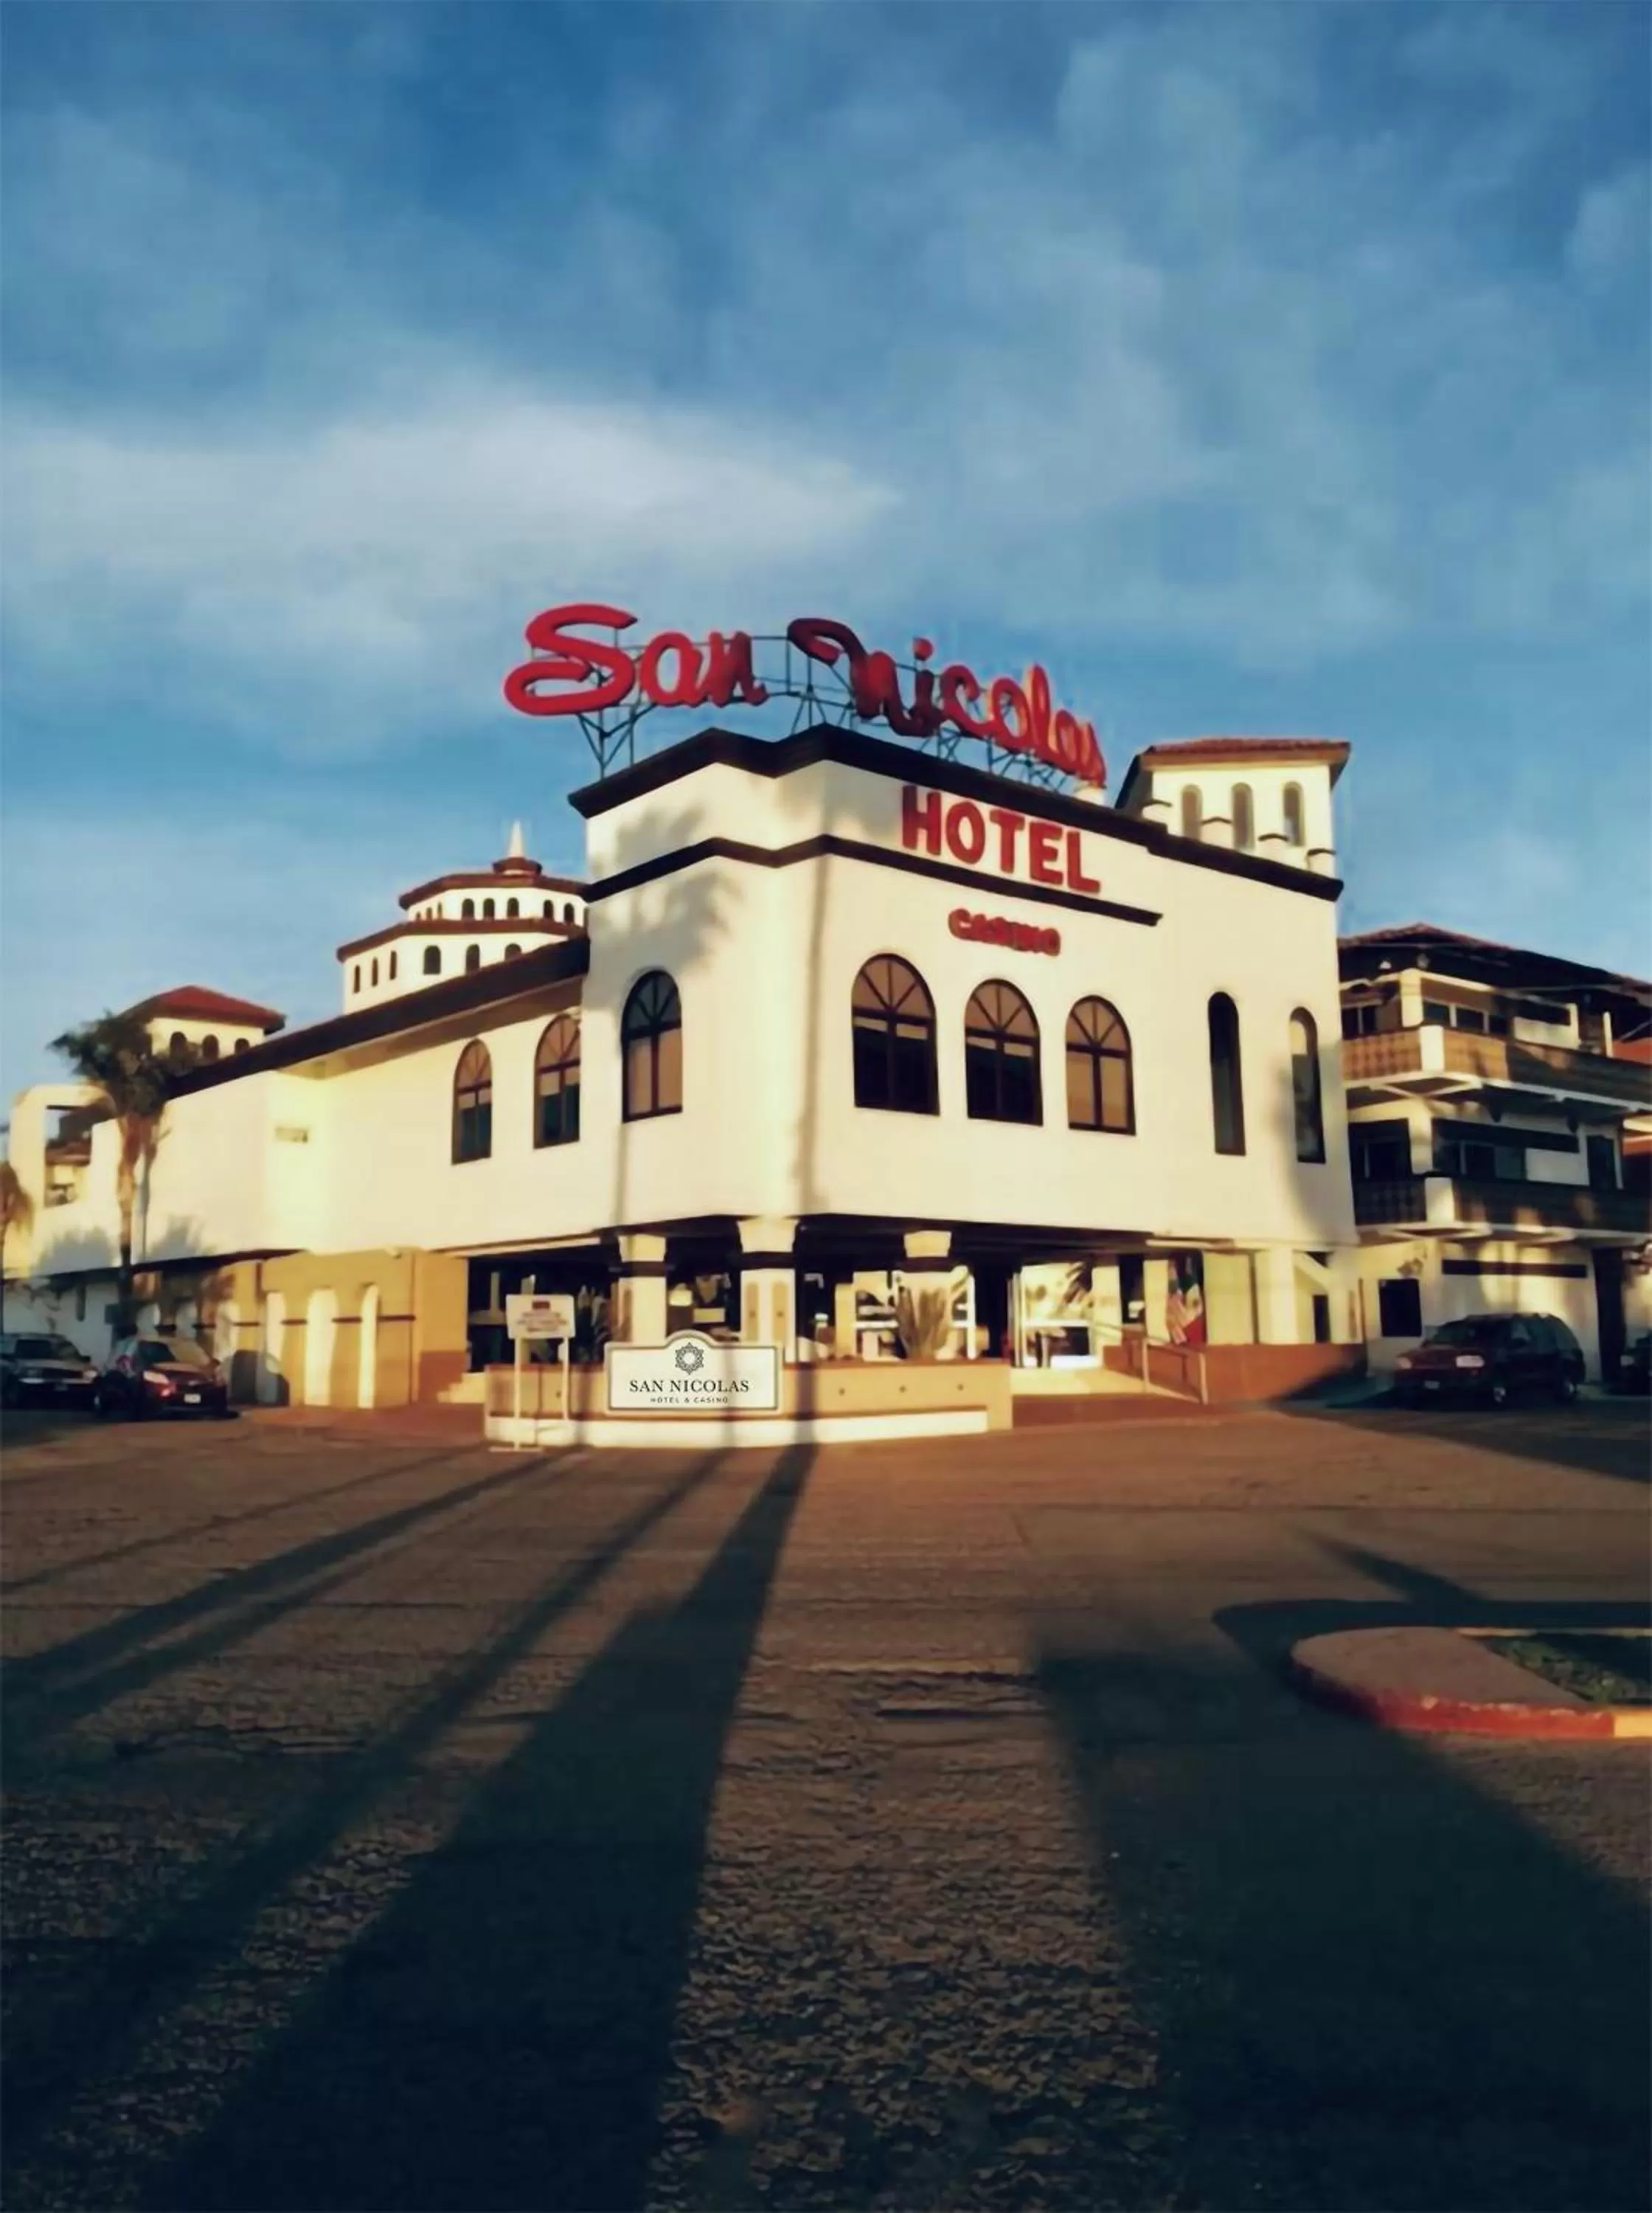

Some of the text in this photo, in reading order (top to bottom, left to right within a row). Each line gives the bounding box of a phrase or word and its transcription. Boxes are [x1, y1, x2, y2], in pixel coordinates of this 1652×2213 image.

[504, 603, 767, 716] San
[901, 785, 1101, 893] HOTEL
[629, 1379, 749, 1393] SAN NICOLAS
